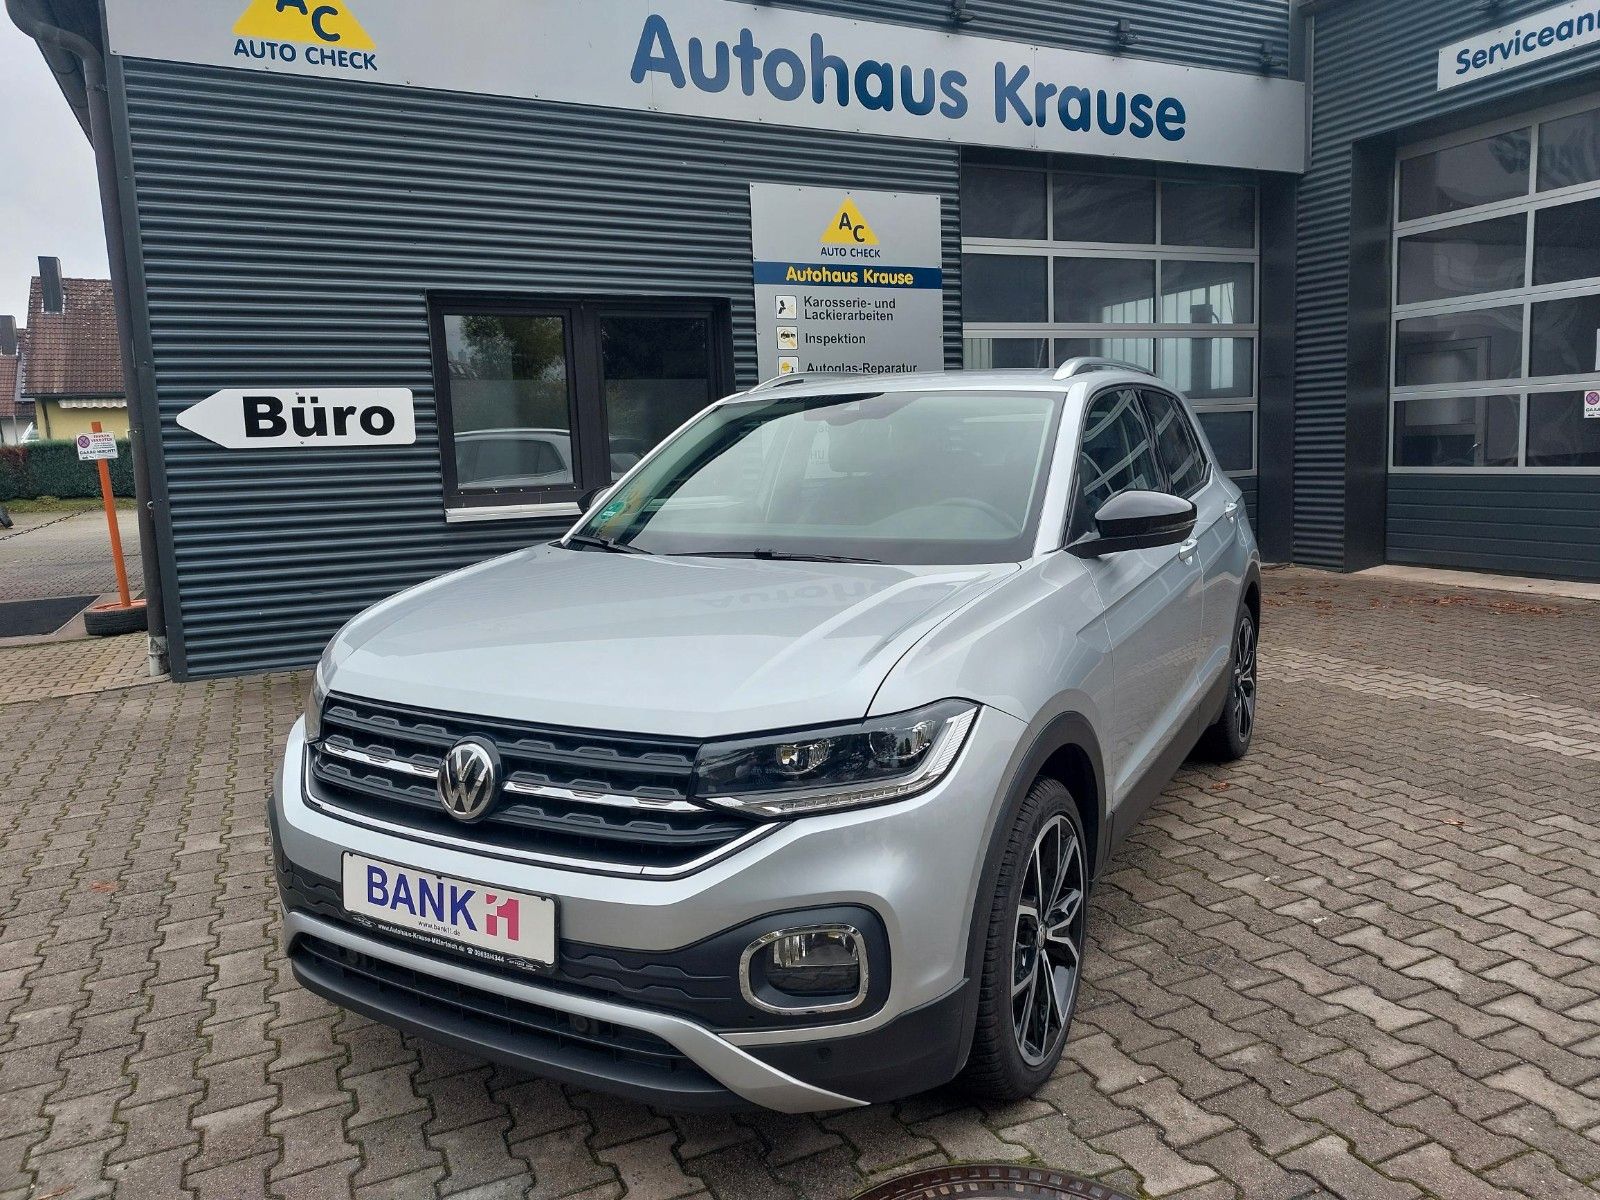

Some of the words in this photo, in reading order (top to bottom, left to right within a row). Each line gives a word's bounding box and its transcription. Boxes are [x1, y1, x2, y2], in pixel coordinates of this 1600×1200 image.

[1456, 9, 1600, 75] Servicean
[234, 39, 297, 62] AUTO
[305, 46, 378, 71] CHECK
[630, 13, 968, 119] Autohaus
[994, 61, 1186, 142] Krause
[820, 246, 847, 257] AUTO
[850, 247, 881, 258] CHECK
[785, 265, 859, 283] Autohaus
[863, 268, 914, 285] Krause
[803, 295, 871, 309] Karosserie-
[874, 297, 896, 309] und
[804, 308, 894, 321] Lackierarbeiten
[805, 332, 866, 347] Inspektion
[806, 362, 918, 375] Autoglas-Reparatur
[242, 396, 395, 438] Büro
